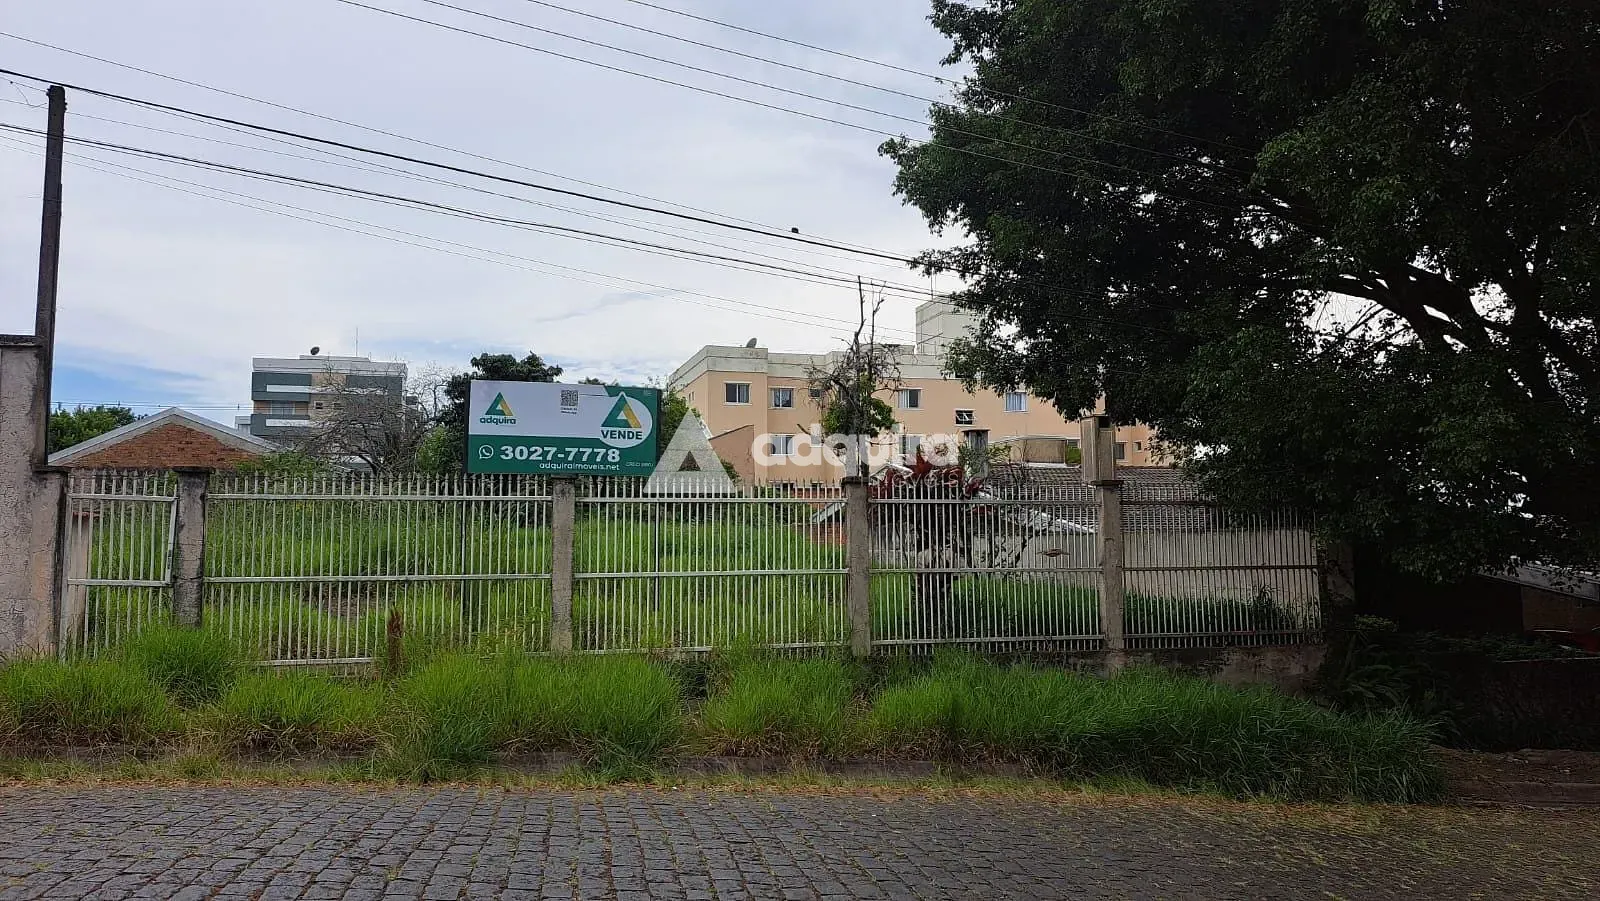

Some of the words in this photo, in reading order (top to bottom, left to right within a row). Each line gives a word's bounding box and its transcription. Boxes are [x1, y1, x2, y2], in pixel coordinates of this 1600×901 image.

[480, 416, 516, 425] adquira
[601, 430, 643, 440] VENDE
[500, 446, 620, 462] 3027-7778
[540, 462, 620, 471] adquiraimoveis.net
